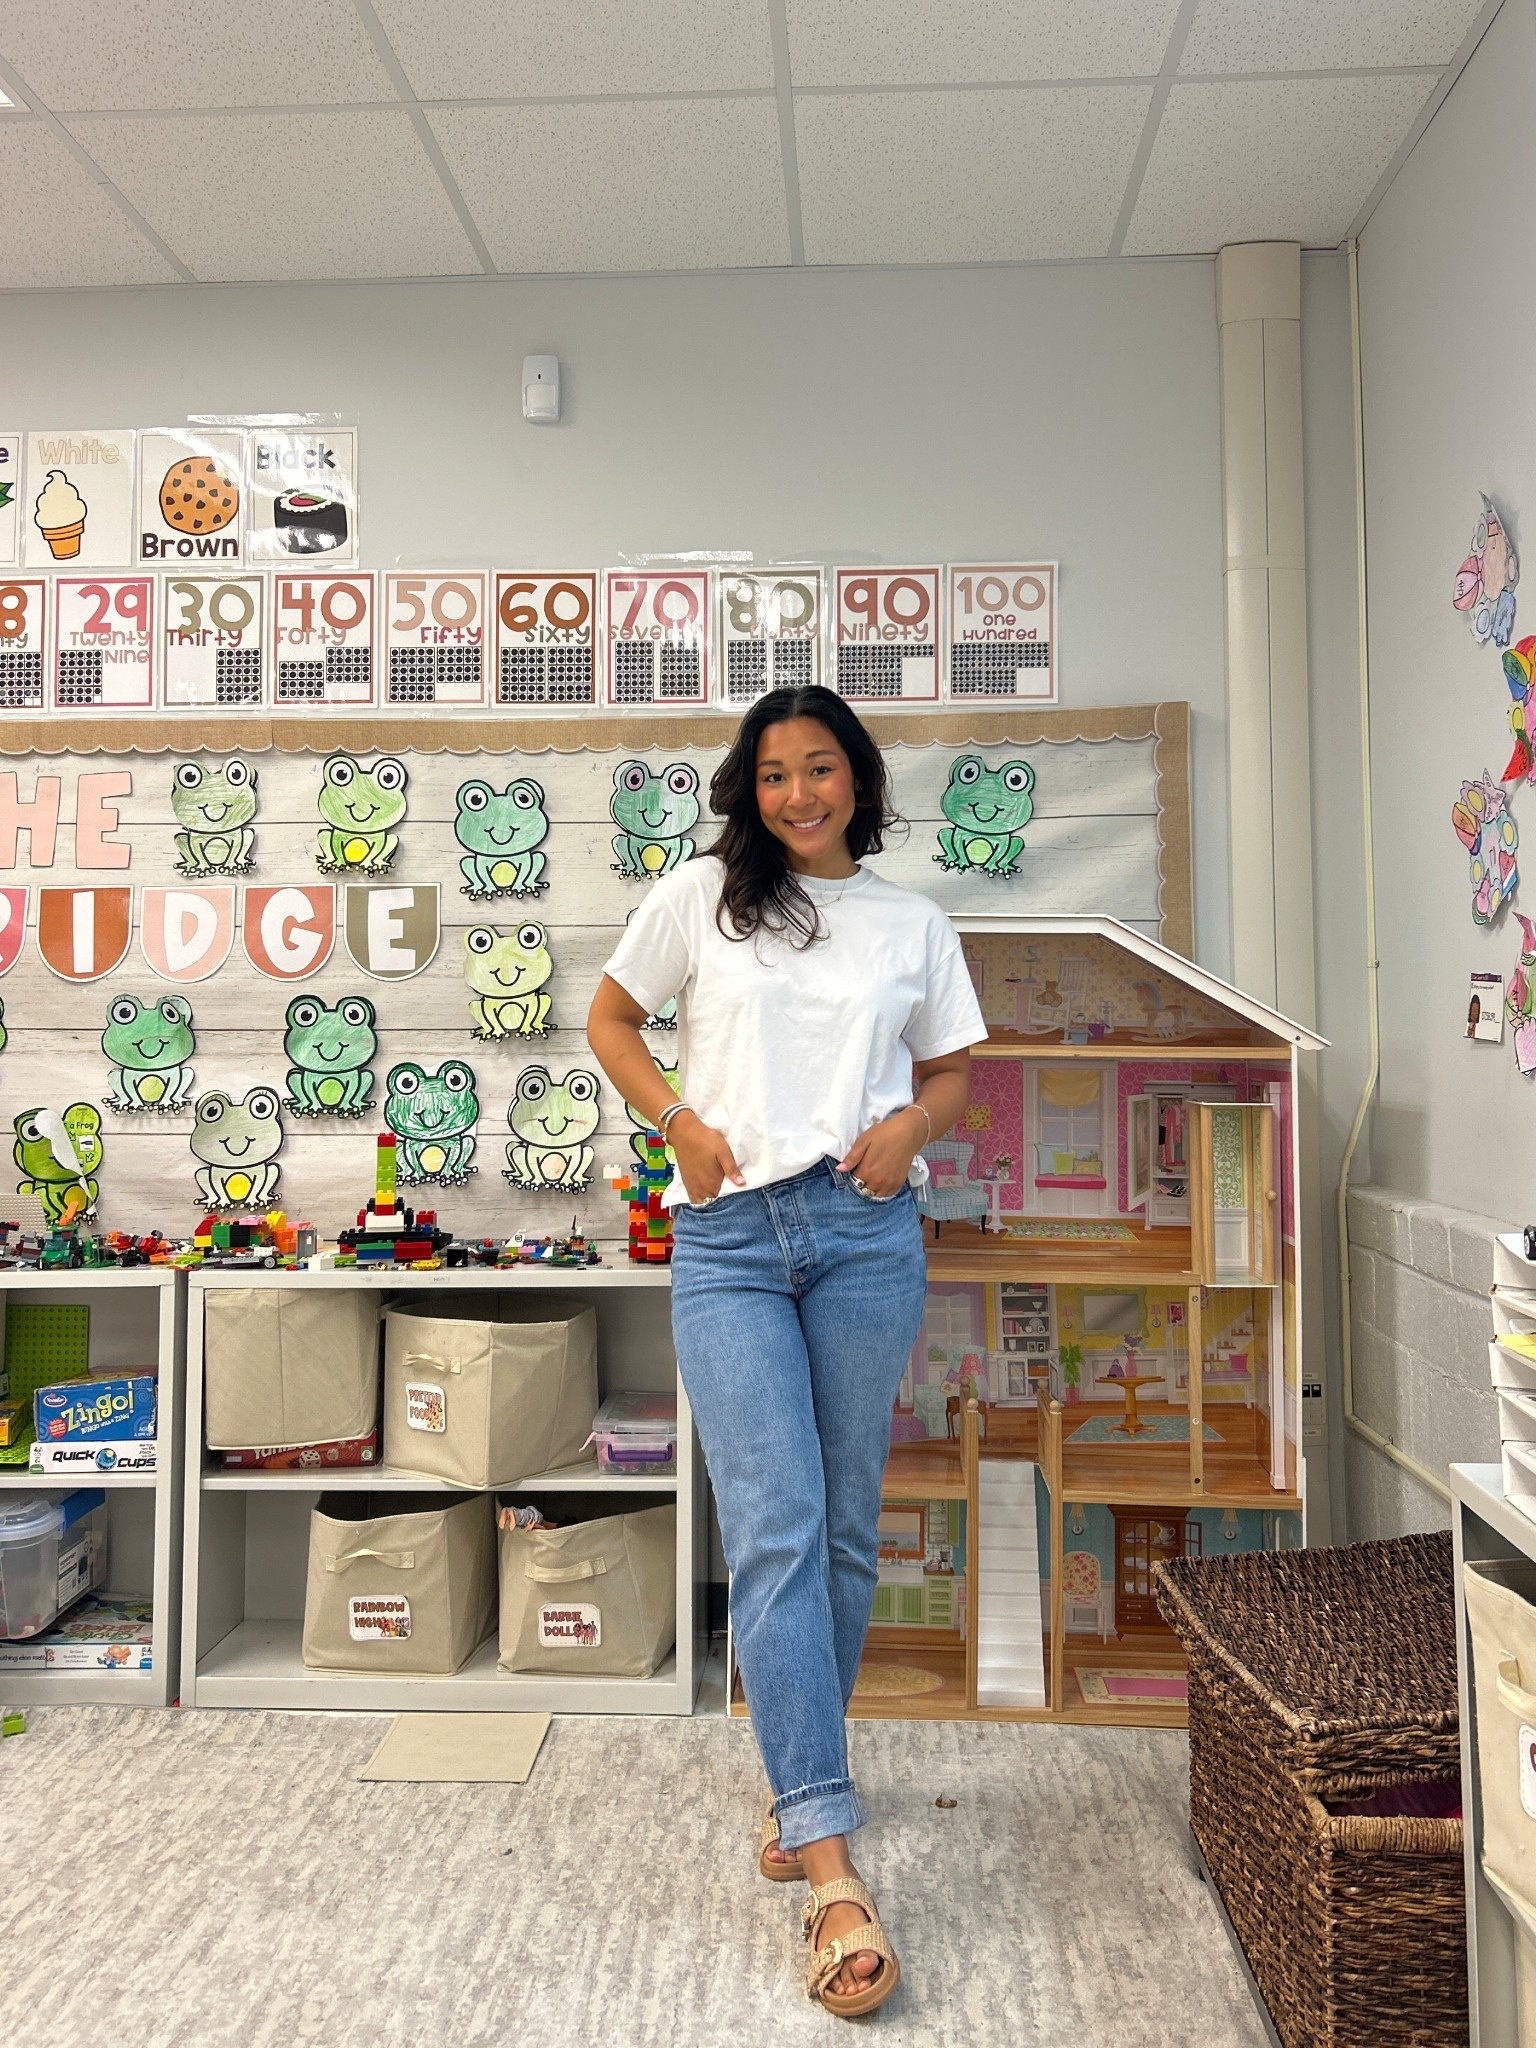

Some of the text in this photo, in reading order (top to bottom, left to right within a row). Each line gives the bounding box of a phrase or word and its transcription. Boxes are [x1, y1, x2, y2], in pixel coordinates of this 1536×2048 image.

[38, 438, 120, 466] White
[141, 533, 240, 558] Brown
[282, 582, 366, 632] 40
[392, 581, 477, 631] 50
[500, 582, 590, 632] 60
[615, 581, 698, 632] 70
[727, 579, 815, 633] 80
[844, 577, 930, 627] 90
[956, 575, 1046, 614] 100
[78, 584, 147, 633] 29
[172, 583, 254, 634] 30
[70, 631, 150, 647] Twenty
[166, 628, 243, 648] Thirty
[277, 627, 347, 646] Forty
[420, 626, 482, 646] Fifty
[524, 625, 590, 645] Sixty
[840, 622, 929, 642] Ninety
[963, 628, 1037, 641] Hundred
[104, 650, 149, 663] Nine
[61, 1381, 134, 1432] Zingo!
[353, 1602, 405, 1613] RAINBOW
[543, 1611, 582, 1622] BARBIE
[544, 1625, 581, 1637] DOLLS
